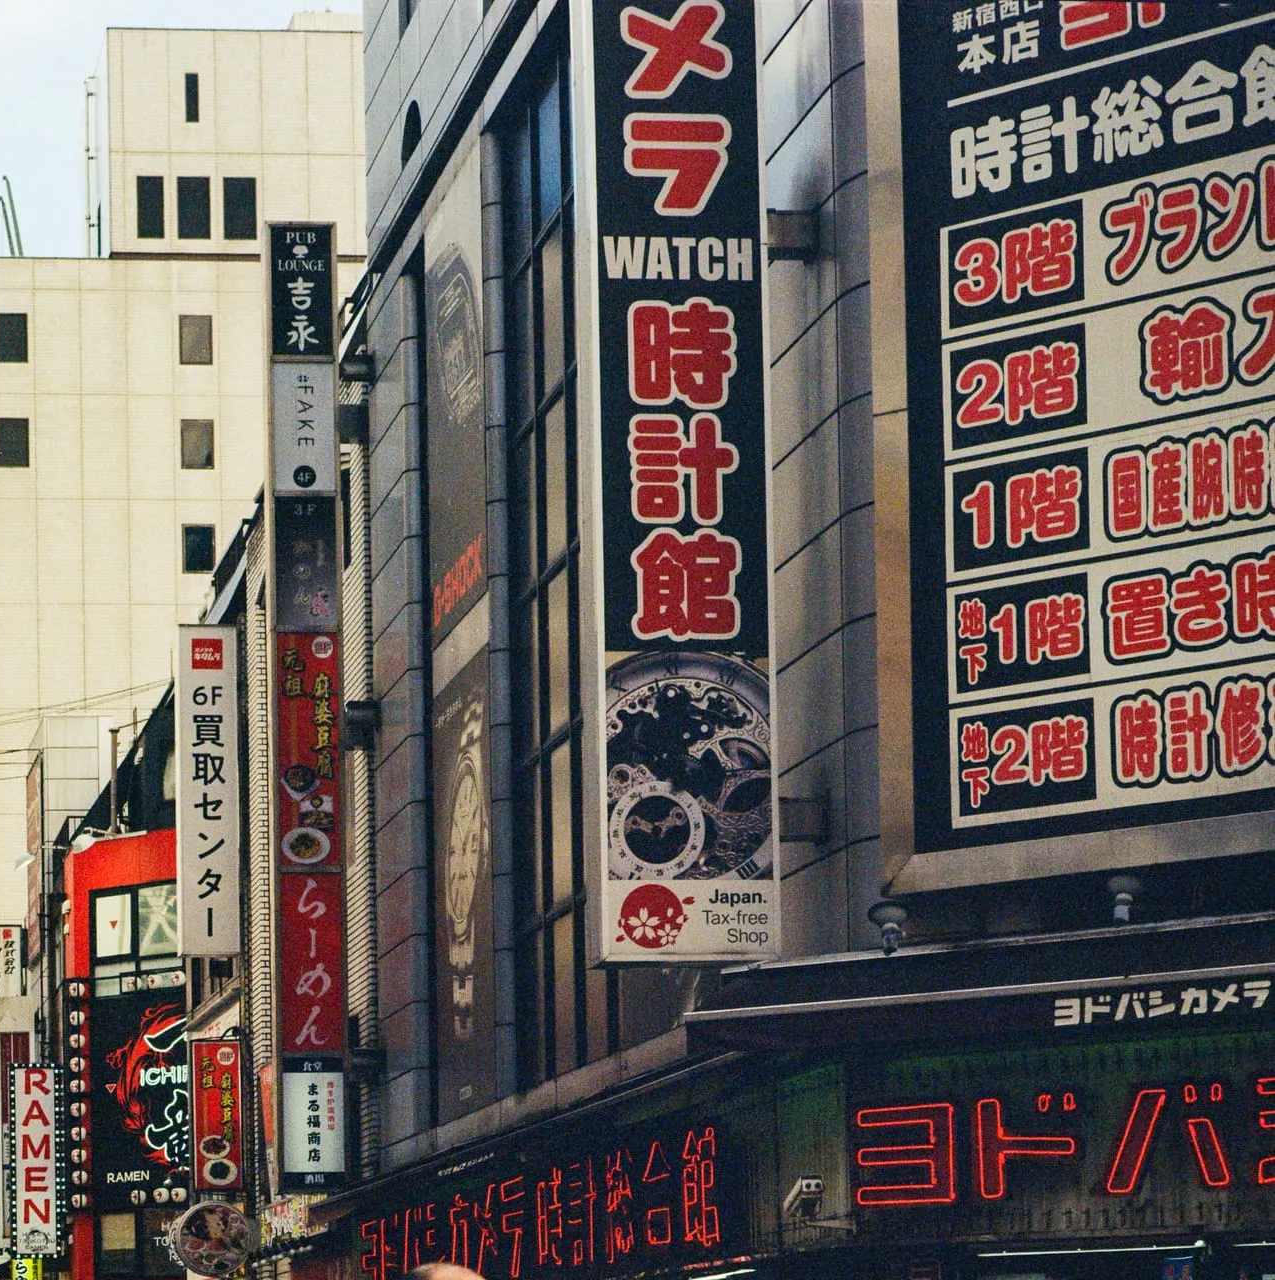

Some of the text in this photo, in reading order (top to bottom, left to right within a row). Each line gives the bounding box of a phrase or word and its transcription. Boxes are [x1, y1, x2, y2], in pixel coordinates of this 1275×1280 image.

[957, 20, 1042, 75] 本店
[278, 258, 325, 272] LOUNGE
[286, 232, 316, 244] PUB
[603, 236, 753, 281] WATCH
[953, 218, 1077, 307] 3階
[286, 276, 320, 351] 吉永
[296, 384, 315, 448] FAKE
[956, 341, 1079, 429] 2階
[297, 471, 312, 482] 4F
[627, 297, 742, 640] 時計館
[961, 465, 1082, 549] 1階
[1106, 420, 1275, 540] 国産腕時
[282, 650, 306, 697] 元祖
[959, 593, 1084, 685] 地下1階
[311, 672, 334, 780] 麻婆豆腐
[962, 714, 1087, 808] 地下2階
[1112, 674, 1275, 787] 時計修
[192, 687, 226, 937] 6F 買取センター
[702, 910, 768, 925] Tax-free
[709, 889, 767, 906] Japan.
[727, 928, 768, 946] Shop
[297, 878, 332, 1045] らーめん
[1054, 980, 1272, 1026] ヨドバシカメラ
[21, 1068, 52, 1225] RAMEN
[307, 1082, 321, 1163] まる福商店
[857, 1077, 1275, 1206] ヨドバ
[107, 1170, 150, 1183] RAMEN
